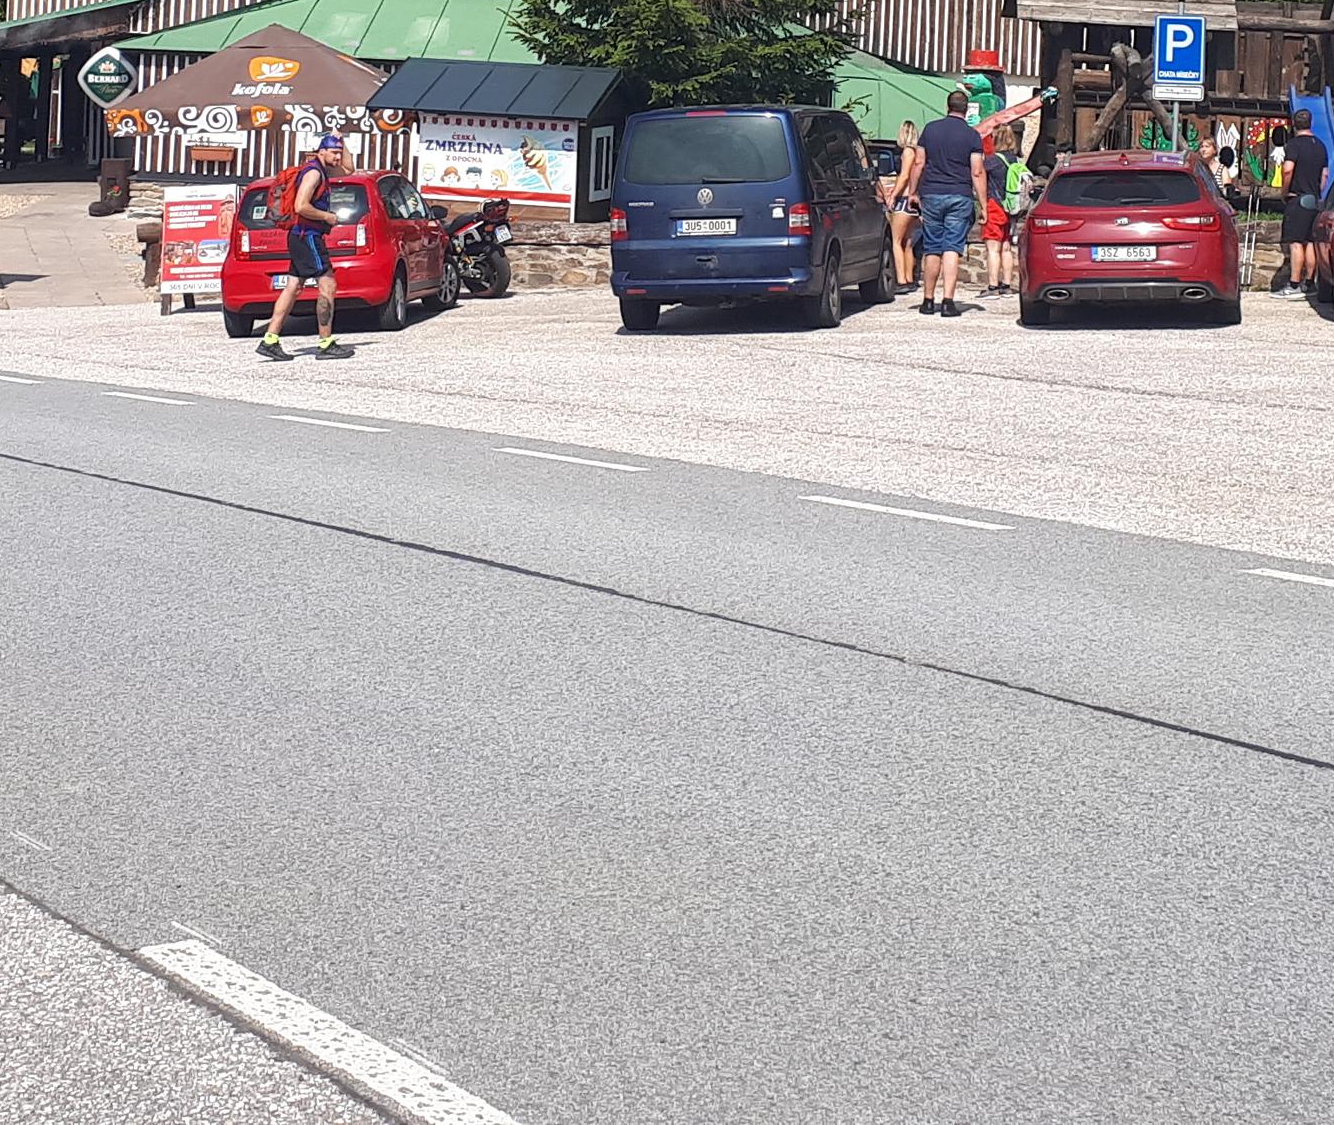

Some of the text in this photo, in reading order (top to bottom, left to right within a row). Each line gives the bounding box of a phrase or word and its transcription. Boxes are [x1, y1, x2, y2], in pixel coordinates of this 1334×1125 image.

[1165, 23, 1194, 62] P
[87, 73, 129, 84] BERNARD
[231, 81, 291, 98] kofola
[425, 139, 504, 155] ZMRZLINA
[685, 220, 731, 231] 3U5 0001
[1100, 247, 1151, 258] 3SZ 6563
